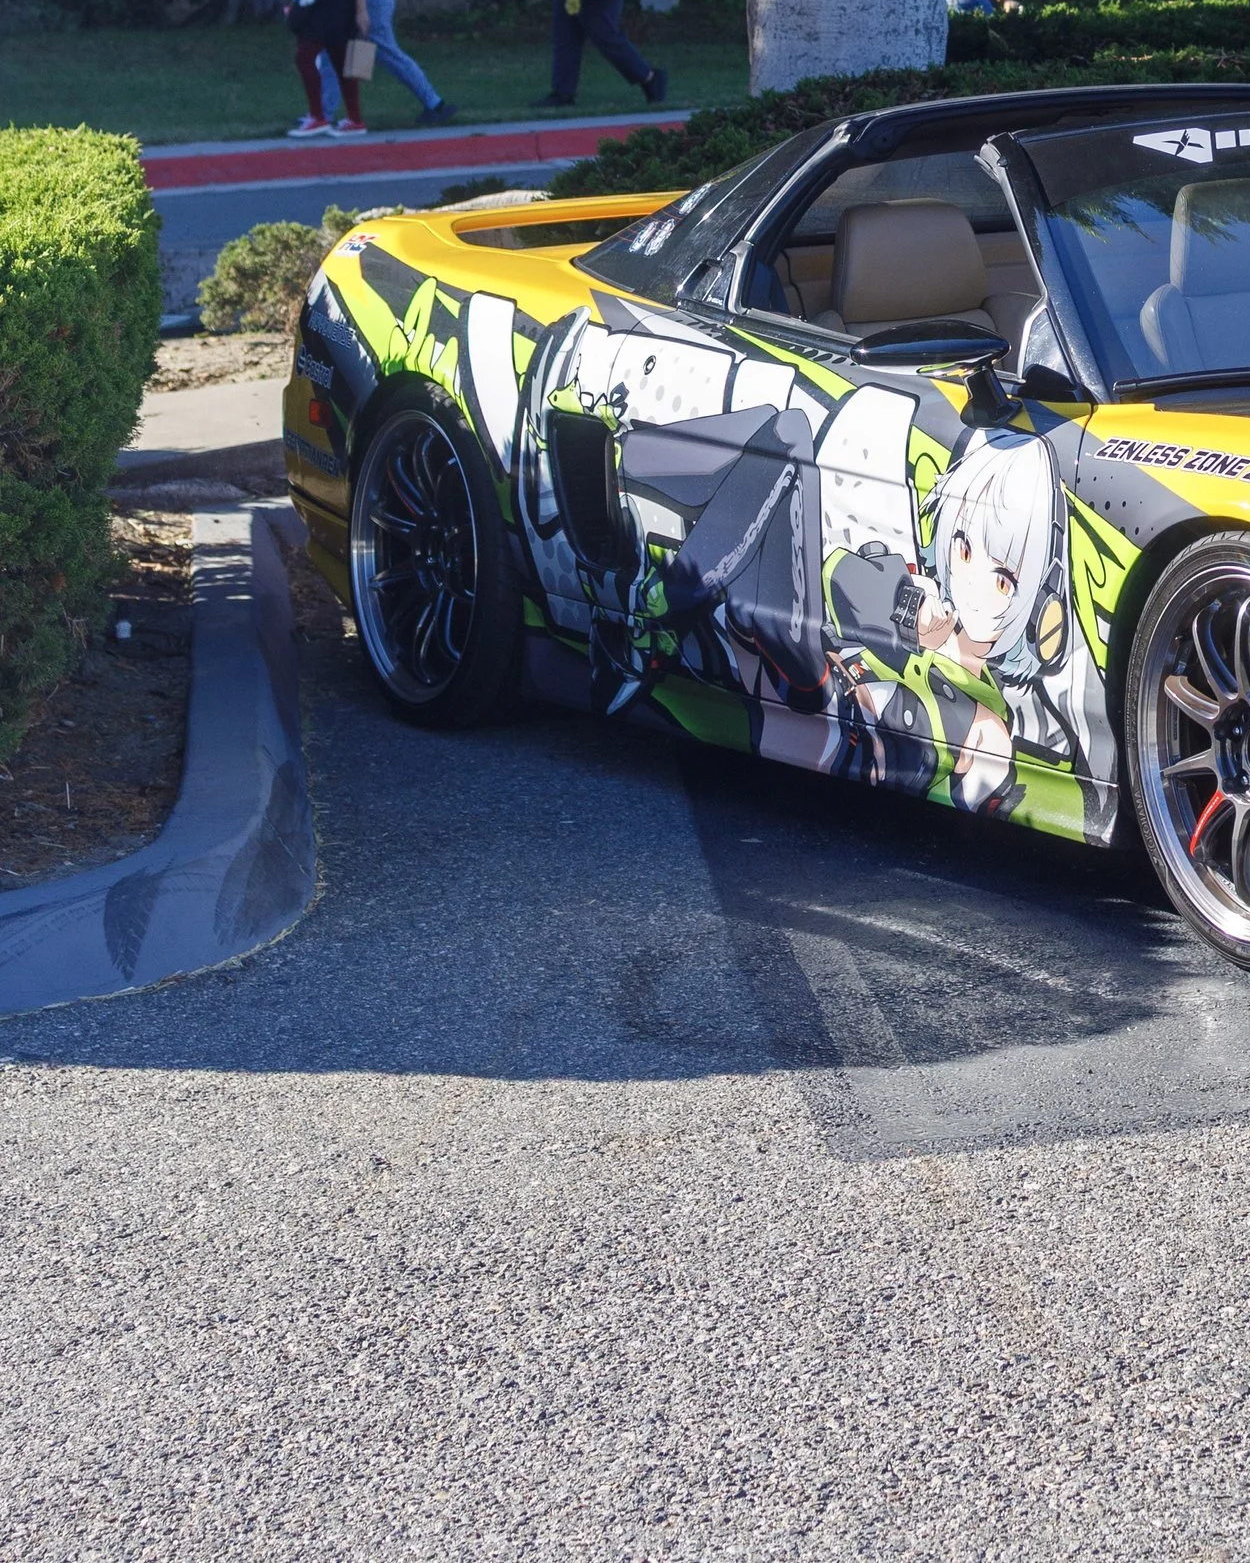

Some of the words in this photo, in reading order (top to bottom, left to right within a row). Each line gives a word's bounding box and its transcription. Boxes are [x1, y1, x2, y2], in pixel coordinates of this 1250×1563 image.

[304, 353, 334, 389] Castrol
[1095, 438, 1191, 467] ZENLESS
[1183, 450, 1250, 477] ZONE
[1133, 789, 1159, 855] YOKOHAMA
